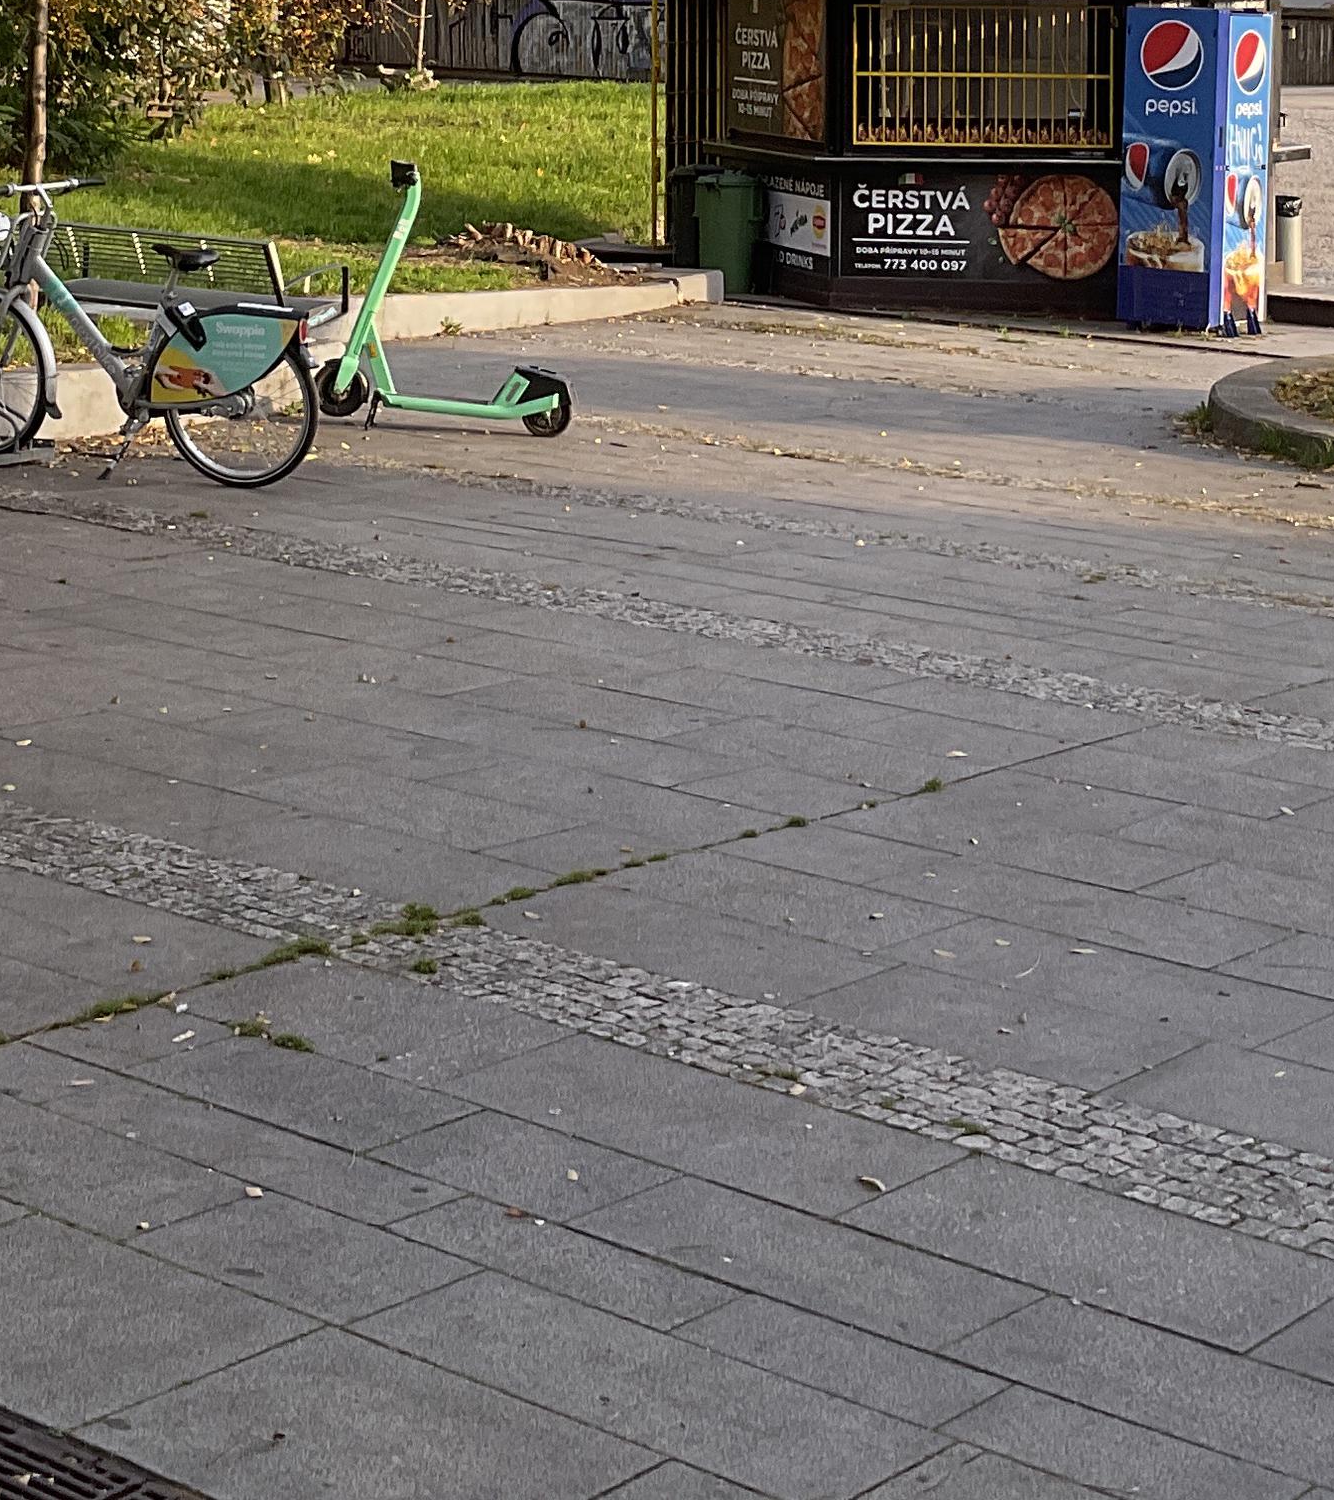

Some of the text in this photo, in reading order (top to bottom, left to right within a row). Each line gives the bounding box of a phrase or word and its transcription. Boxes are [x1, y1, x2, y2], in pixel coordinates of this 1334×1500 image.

[735, 22, 778, 48] ČERSTVÁ
[741, 51, 770, 70] PIZZA
[1145, 97, 1198, 117] pepsi
[1235, 99, 1263, 119] pepsi
[853, 183, 970, 210] ČERSTVÁ
[868, 213, 955, 236] PIZZA
[883, 258, 907, 270] 773
[910, 259, 938, 271] 400
[941, 260, 967, 271] 097
